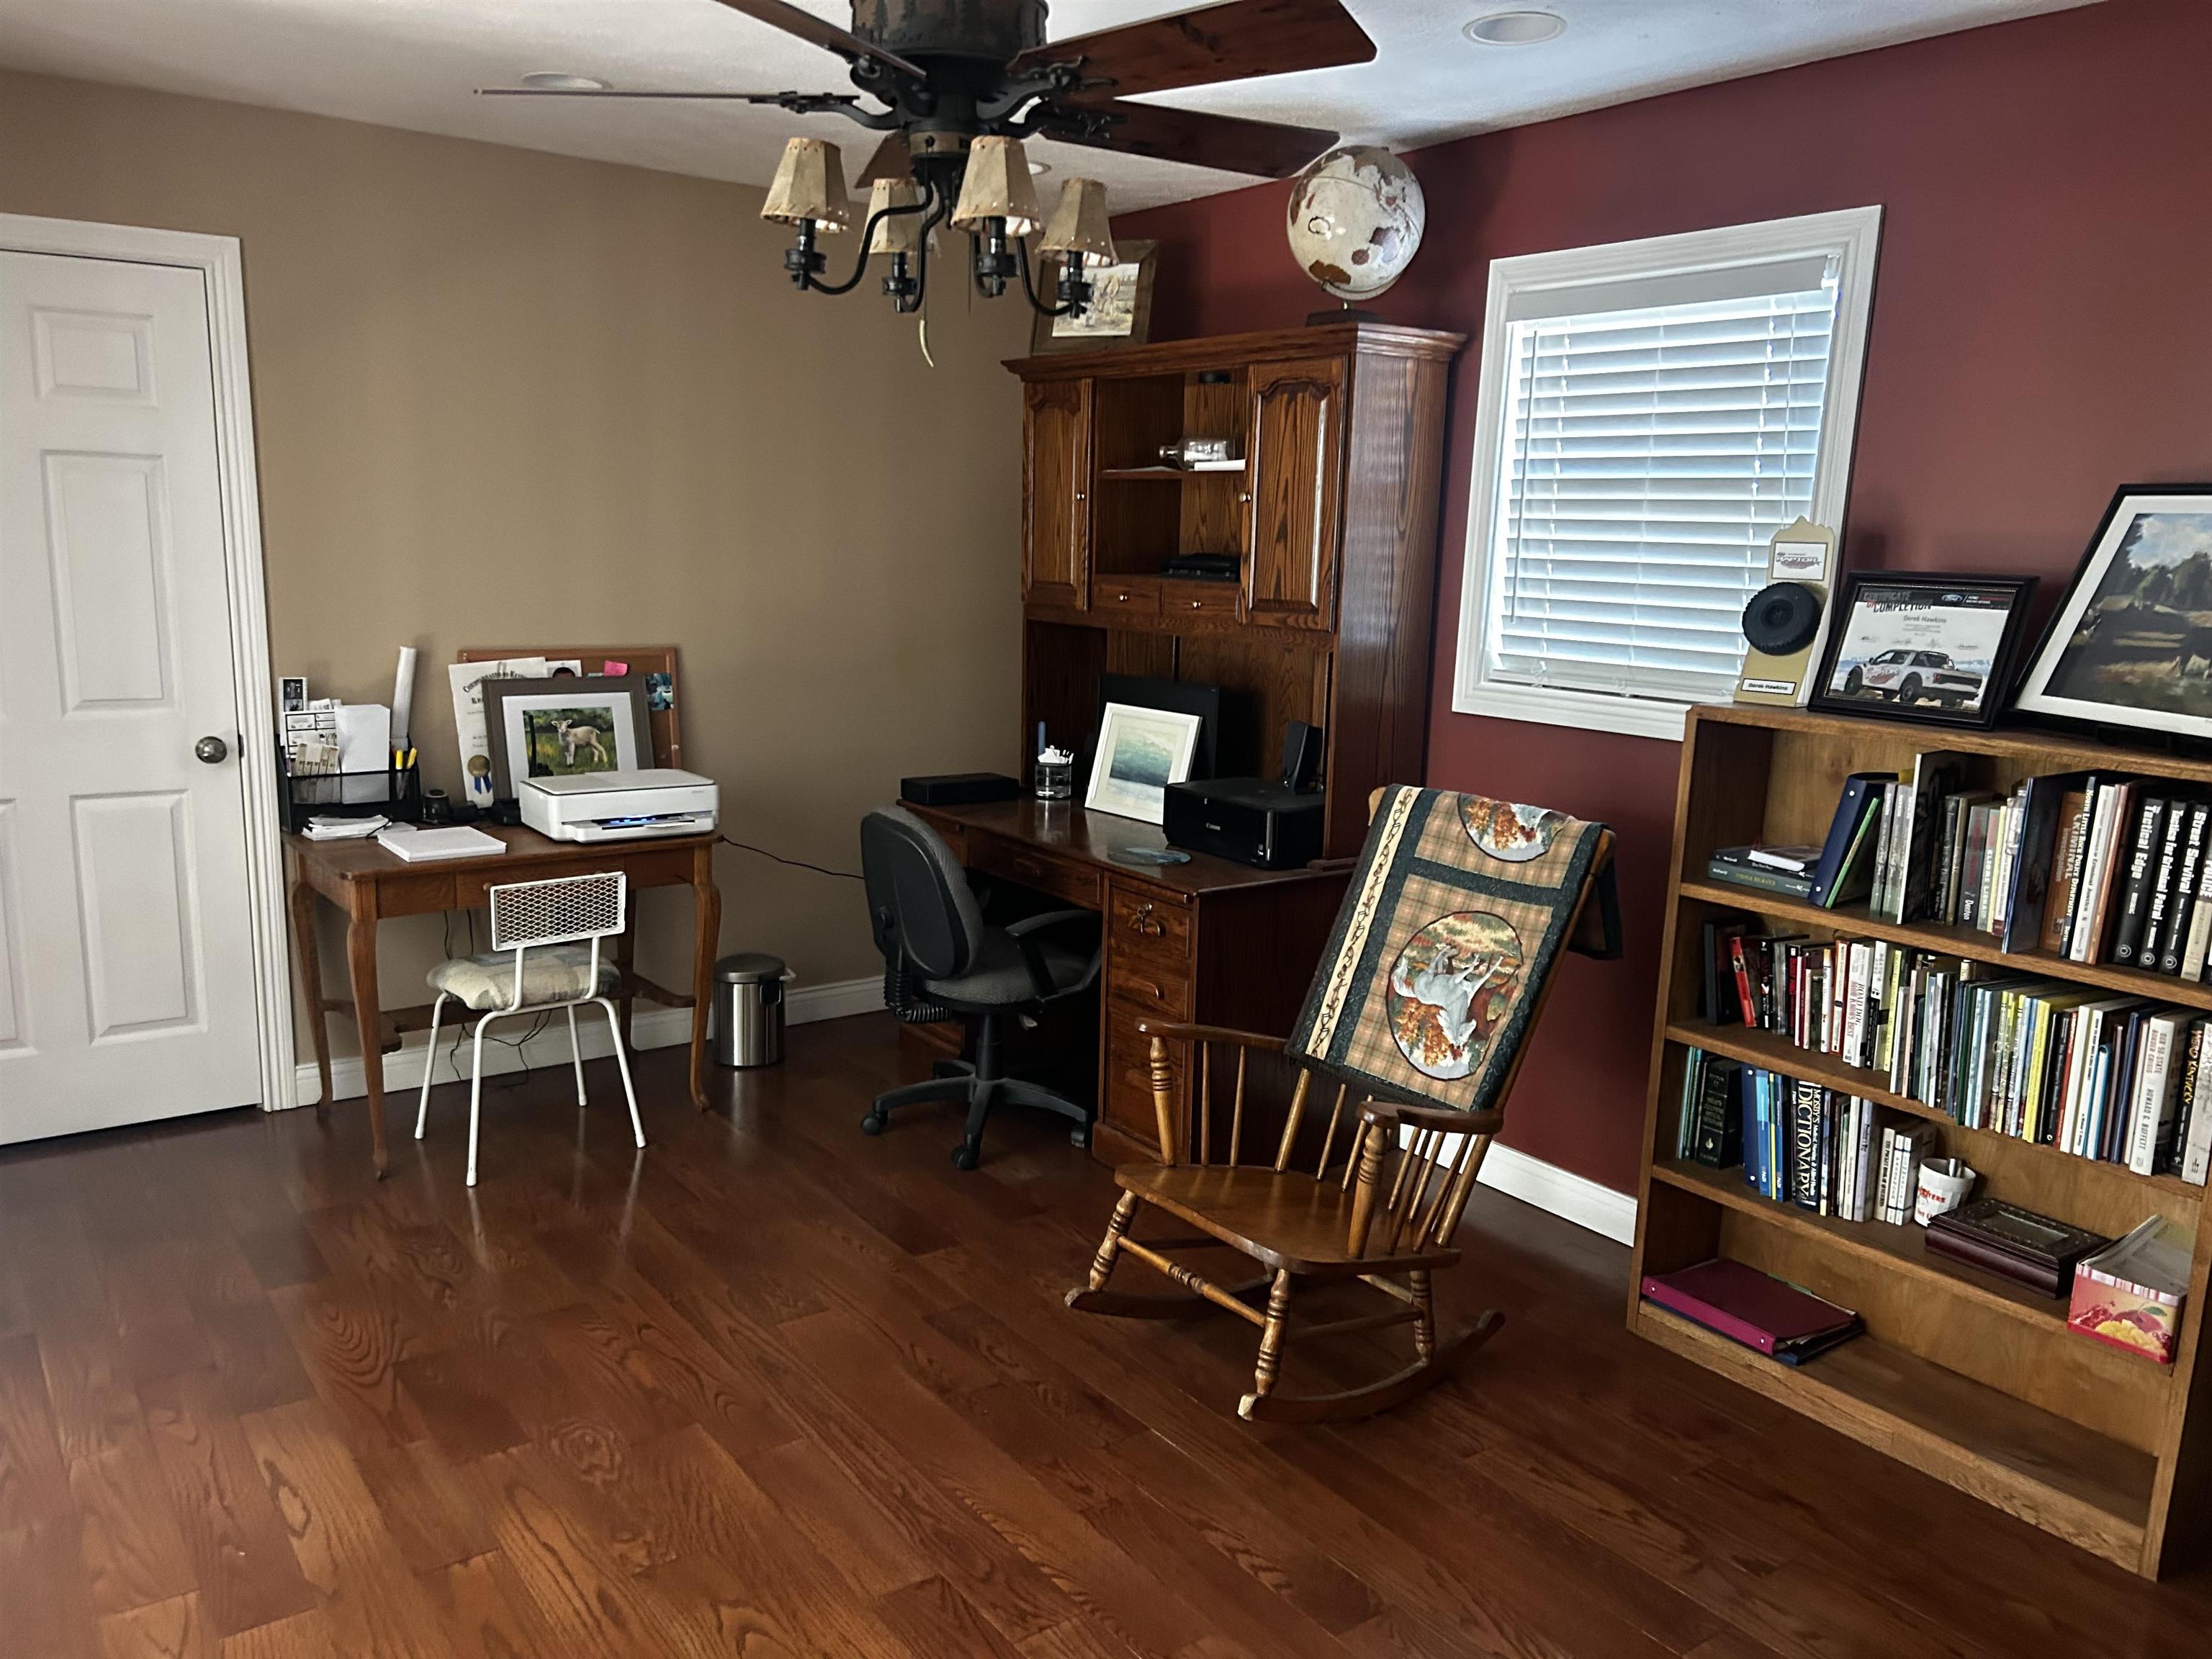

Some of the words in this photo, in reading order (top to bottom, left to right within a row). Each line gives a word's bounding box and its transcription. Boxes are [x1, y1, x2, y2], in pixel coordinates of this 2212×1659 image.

[1873, 599, 1933, 613] COMPLETION
[2083, 789, 2094, 812] NORTH
[2080, 813, 2090, 835] LITTLE
[2138, 806, 2155, 849] Tactical
[2167, 809, 2184, 841] Tactics
[2189, 811, 2207, 847] Street
[2076, 835, 2086, 854] ROCK
[2164, 842, 2177, 855] for
[2072, 854, 2082, 878] POLICE
[2131, 852, 2148, 879] Edge
[2157, 856, 2174, 893] Criminal
[2179, 848, 2198, 894] Survival
[1963, 899, 1974, 920] Denton
[2067, 877, 2079, 917] DEPARTMENT
[2151, 893, 2167, 920] Patrol
[1857, 984, 1866, 1006] ROAD
[1846, 1021, 1855, 1038] BEST
[1854, 1007, 1863, 1025] DOG
[2159, 1033, 2167, 1044] OUR
[2155, 1046, 2164, 1074] 50-STATE
[2182, 1060, 2198, 1105] KENTUCKY
[1812, 1088, 1821, 1124] MOSBY'S
[2144, 1088, 2154, 1113] HOWARD
[1796, 1085, 1814, 1197] DICTIONARY
[2139, 1123, 2149, 1150] BUFFETT
